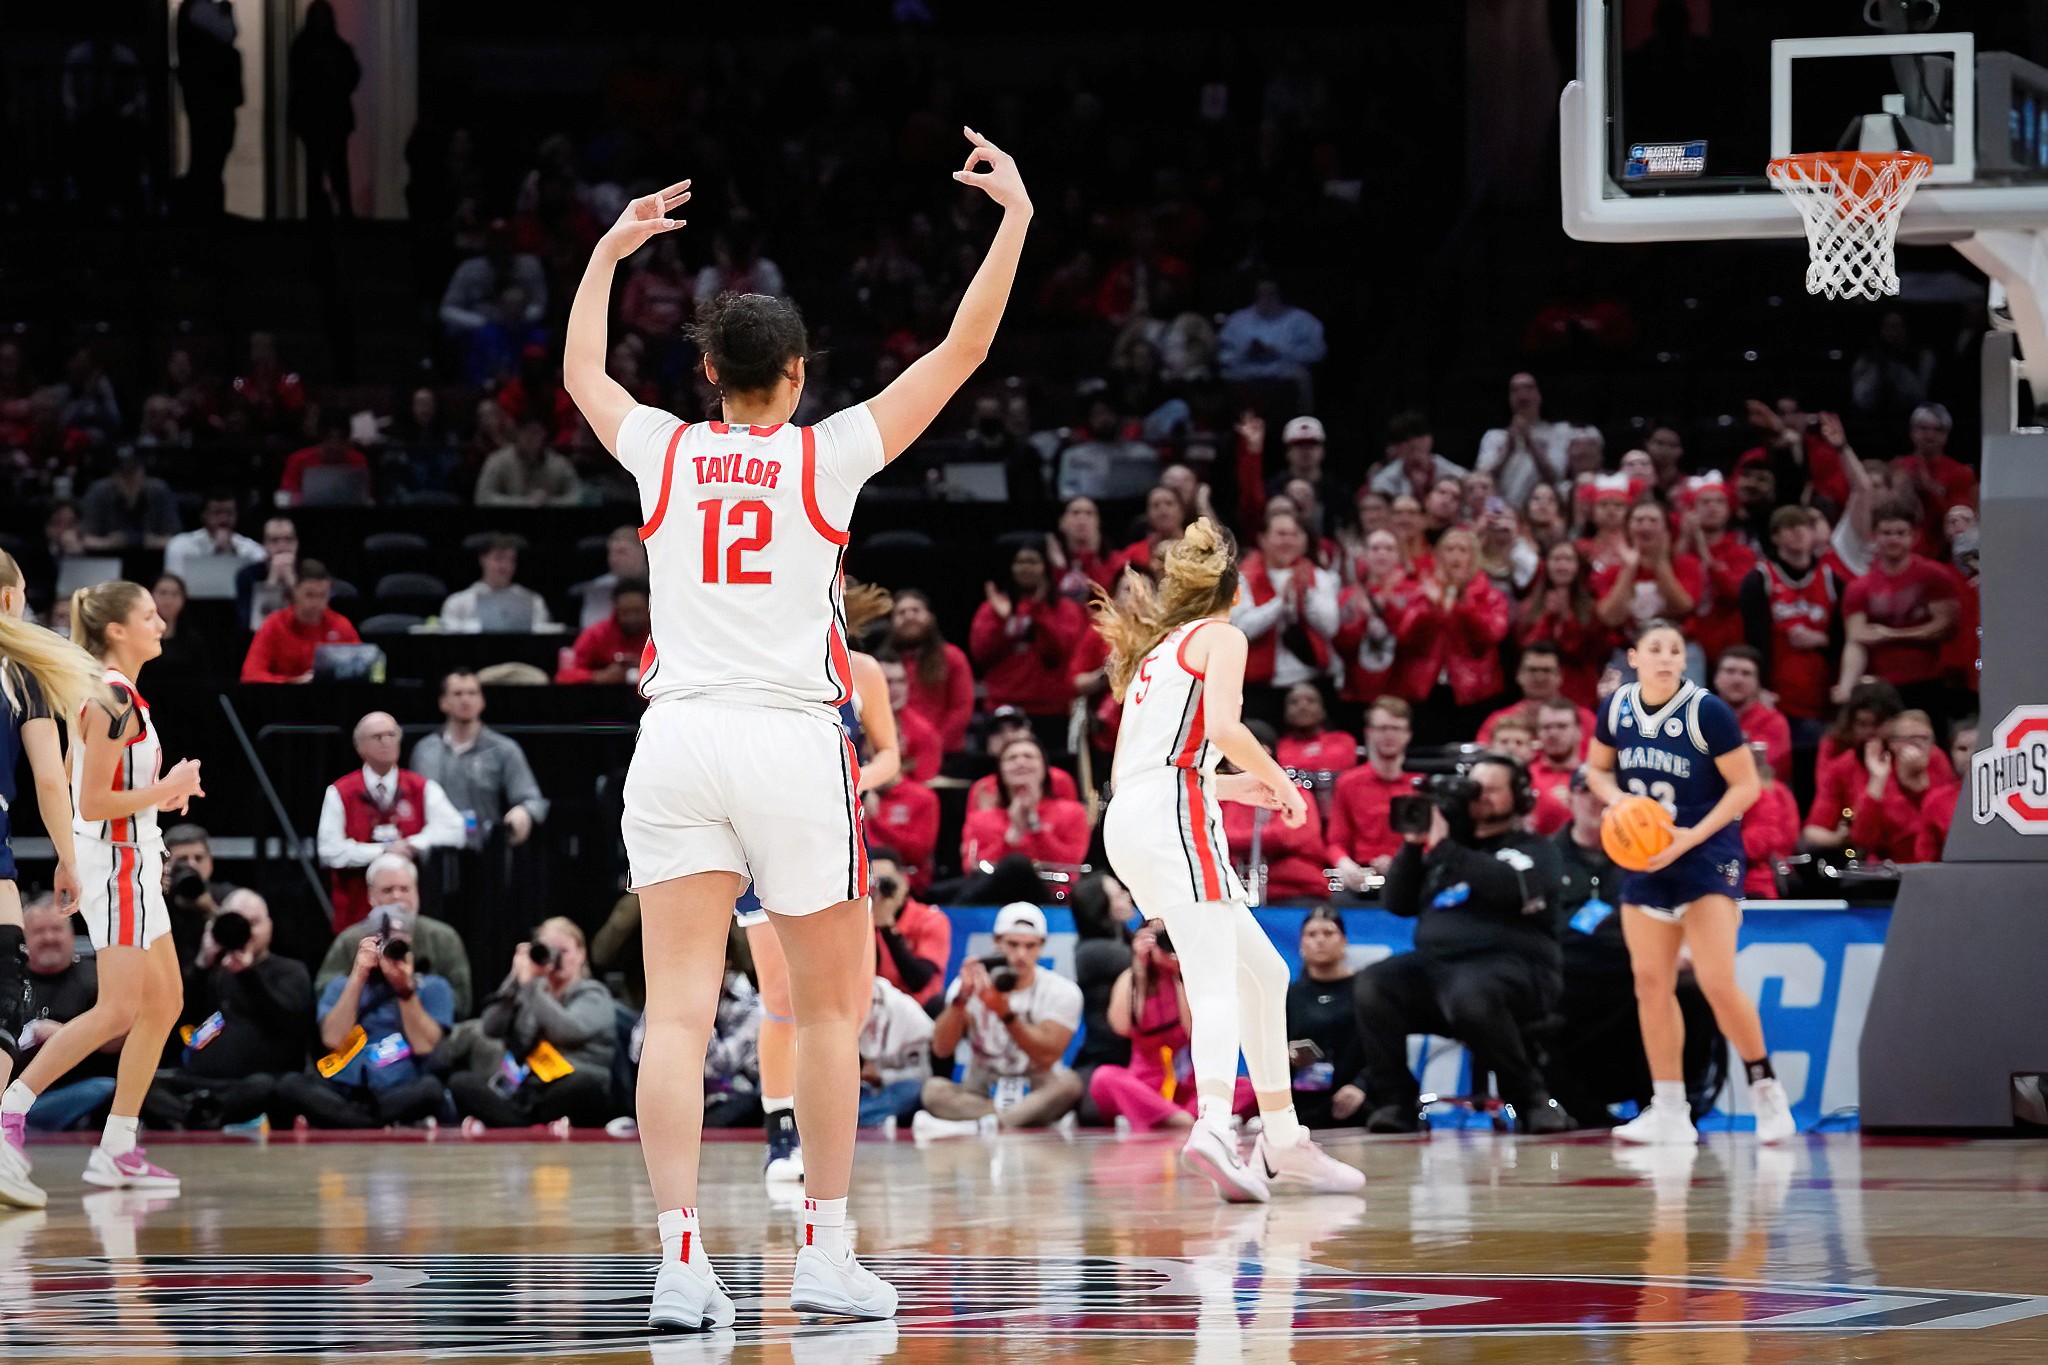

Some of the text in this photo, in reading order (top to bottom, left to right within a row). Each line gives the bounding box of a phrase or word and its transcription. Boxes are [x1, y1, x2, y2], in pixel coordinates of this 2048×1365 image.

[692, 453, 782, 490] TAYLOR
[697, 498, 773, 585] 12
[1135, 655, 1159, 705] 5
[1978, 751, 2028, 818] OHIO
